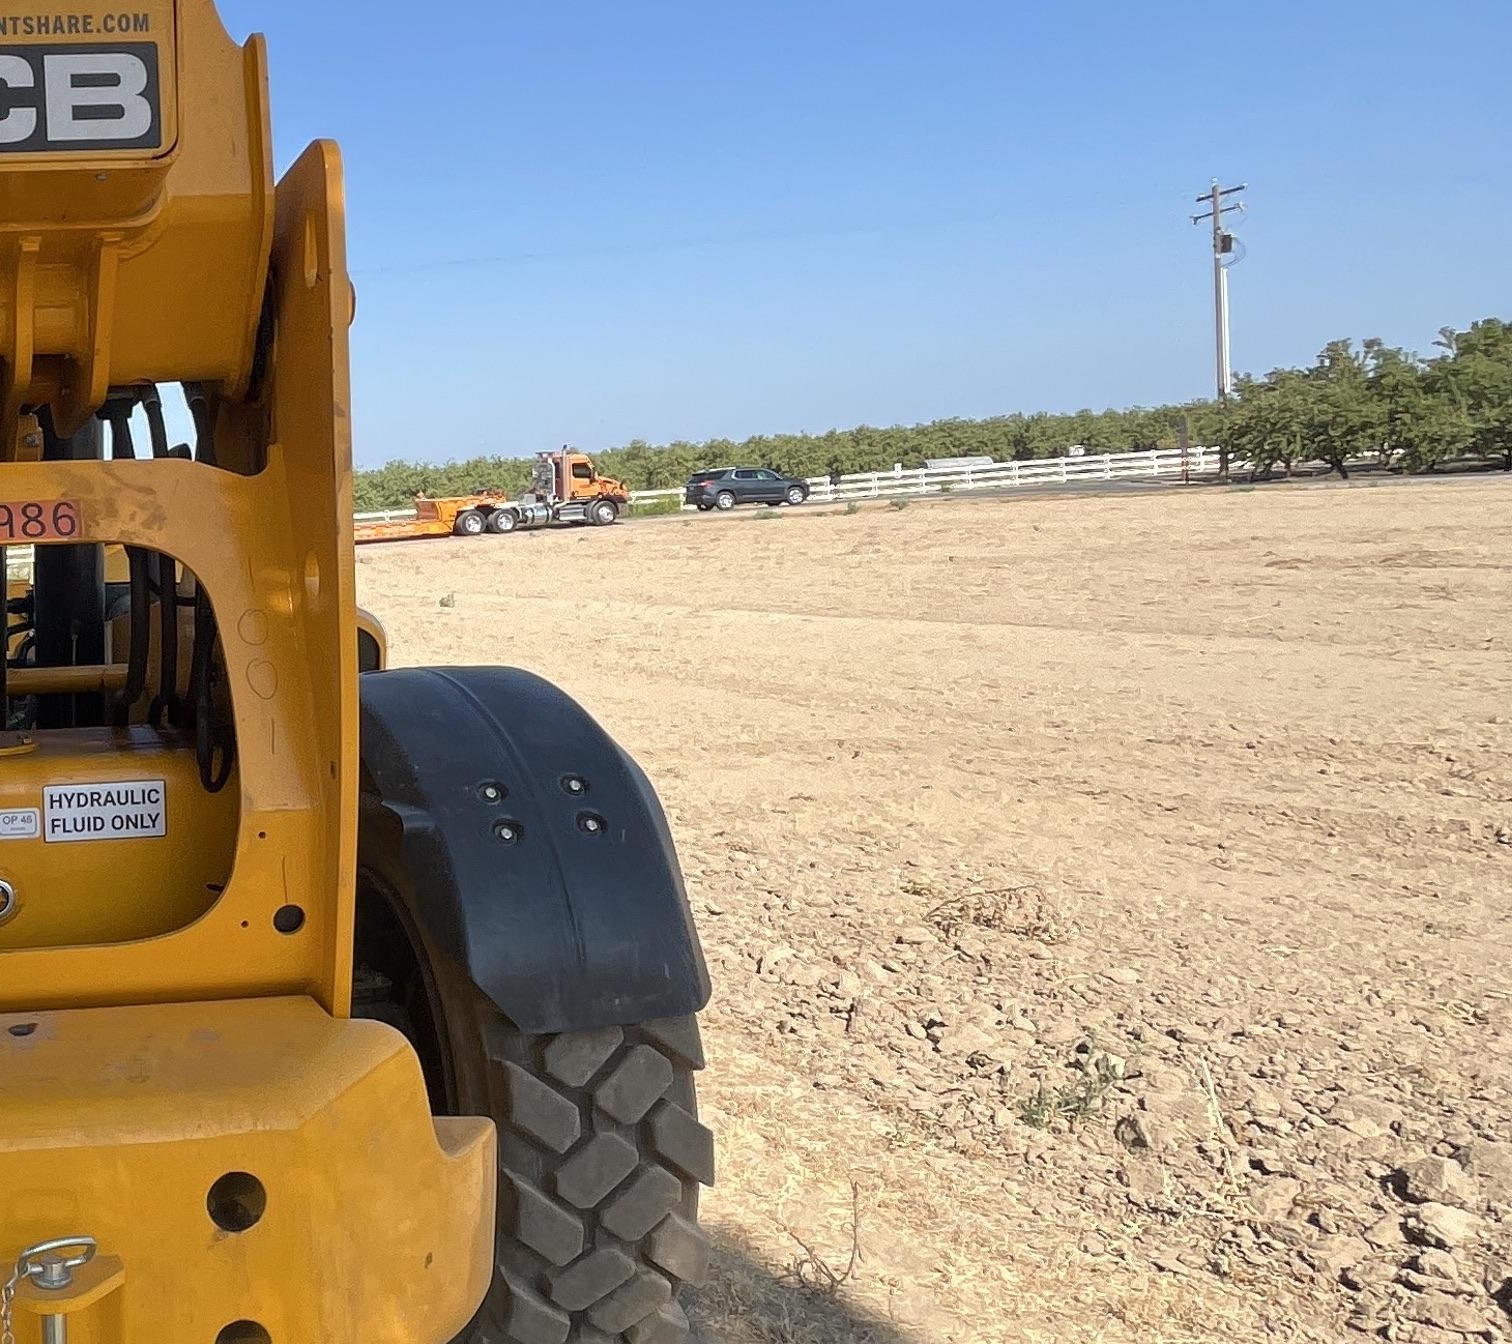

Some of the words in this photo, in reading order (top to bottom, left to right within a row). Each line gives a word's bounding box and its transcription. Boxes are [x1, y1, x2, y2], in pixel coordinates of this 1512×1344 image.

[49, 788, 160, 809] HYDRAULIC
[51, 814, 105, 834] FLUID
[111, 812, 161, 831] ONLY
